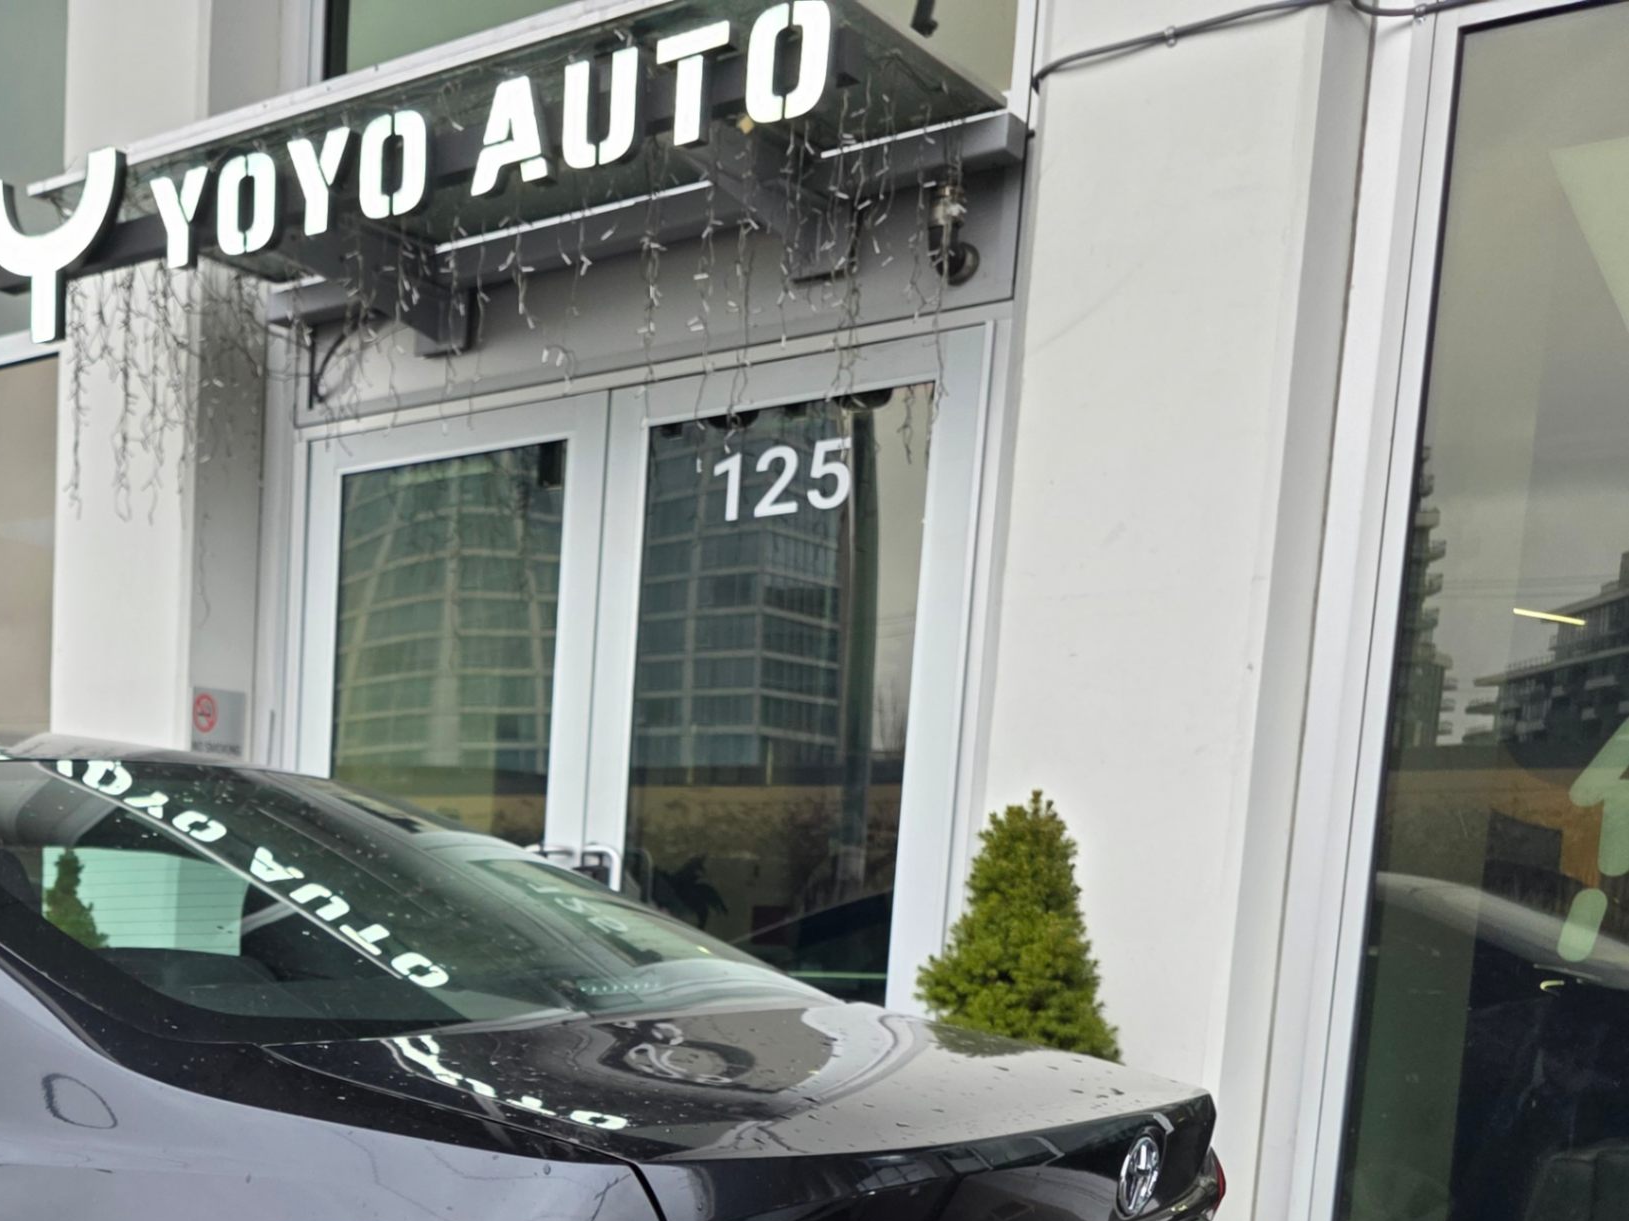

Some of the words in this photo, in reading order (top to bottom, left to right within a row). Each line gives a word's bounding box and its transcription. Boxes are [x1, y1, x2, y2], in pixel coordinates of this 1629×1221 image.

[149, 110, 428, 268] YOYO
[471, 0, 832, 196] AUTO
[713, 437, 852, 522] 125
